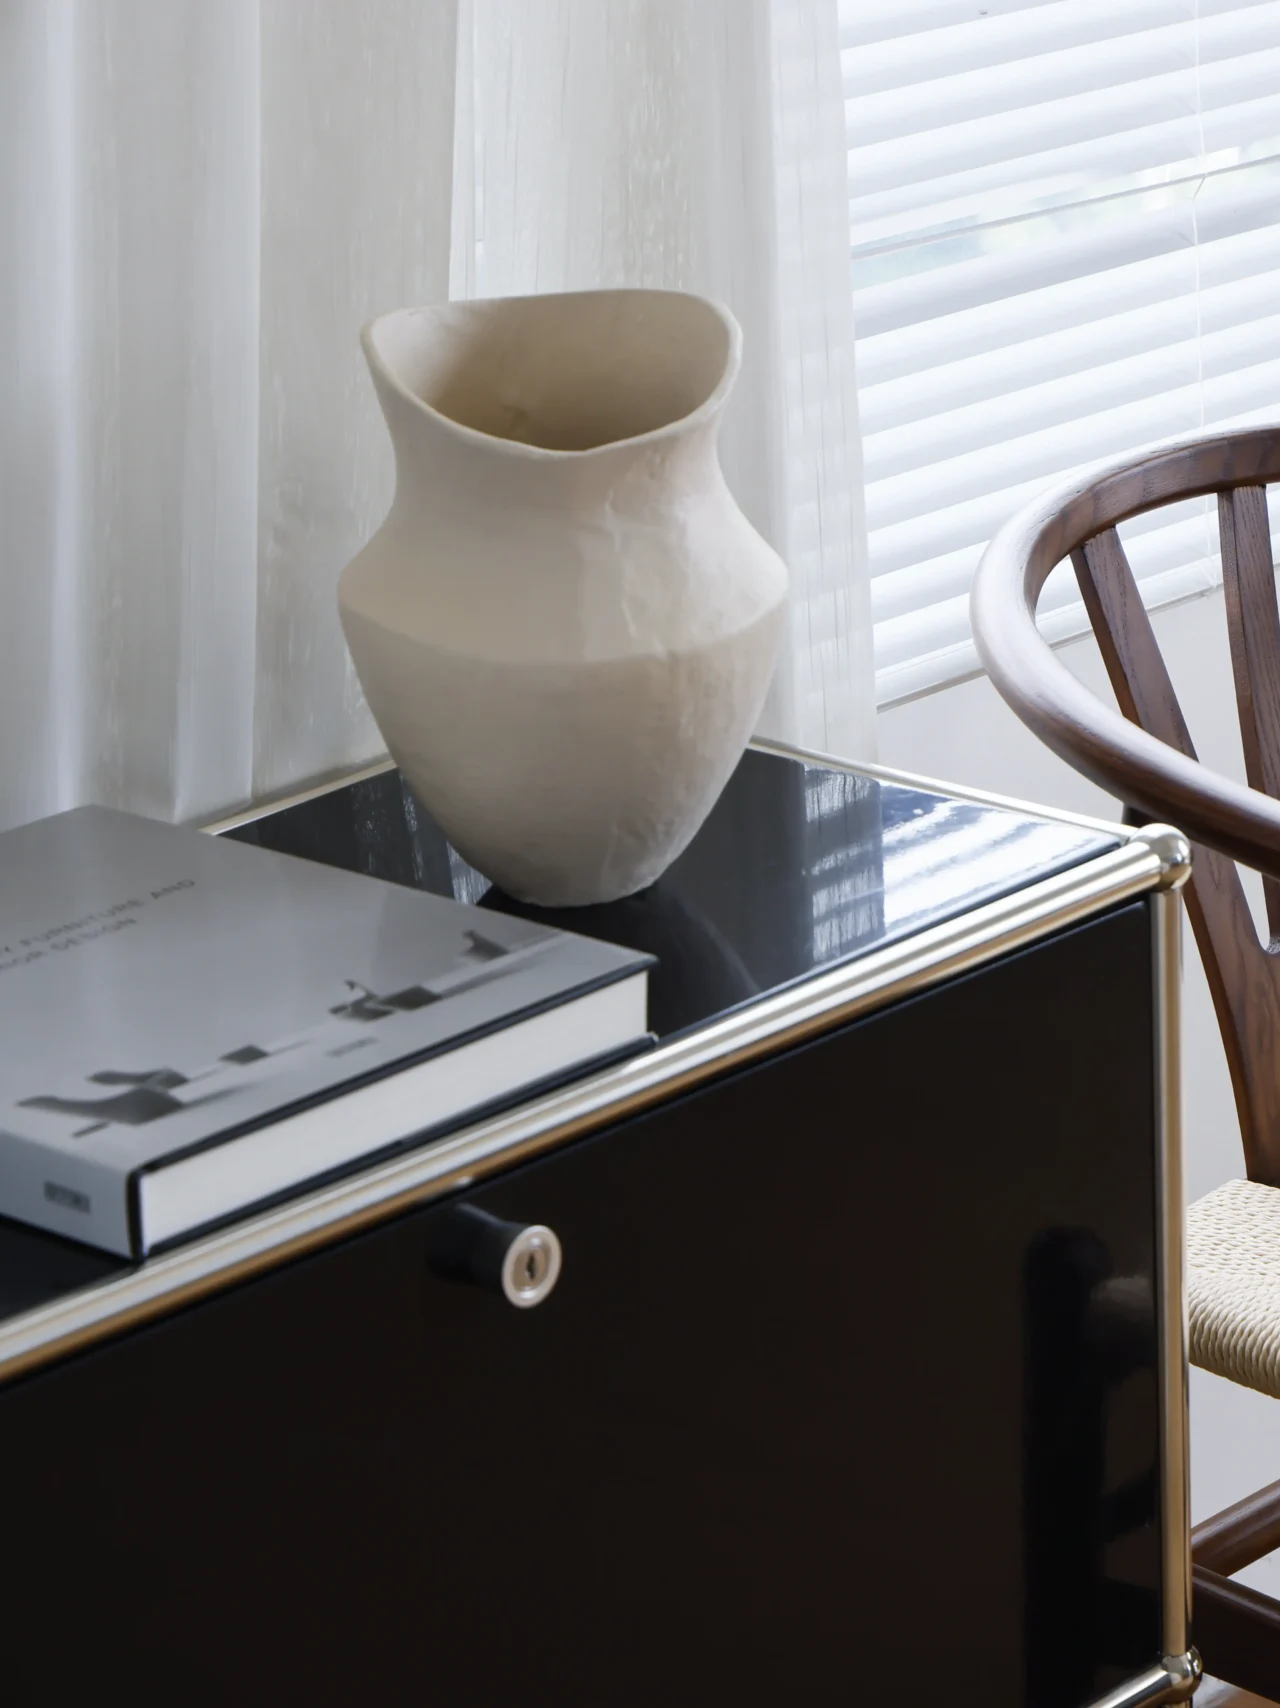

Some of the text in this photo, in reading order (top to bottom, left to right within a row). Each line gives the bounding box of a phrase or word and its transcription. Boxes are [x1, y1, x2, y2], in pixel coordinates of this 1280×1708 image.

[19, 897, 146, 947] FURNITURE
[150, 878, 196, 900] AND
[50, 917, 139, 952] DESIGN
